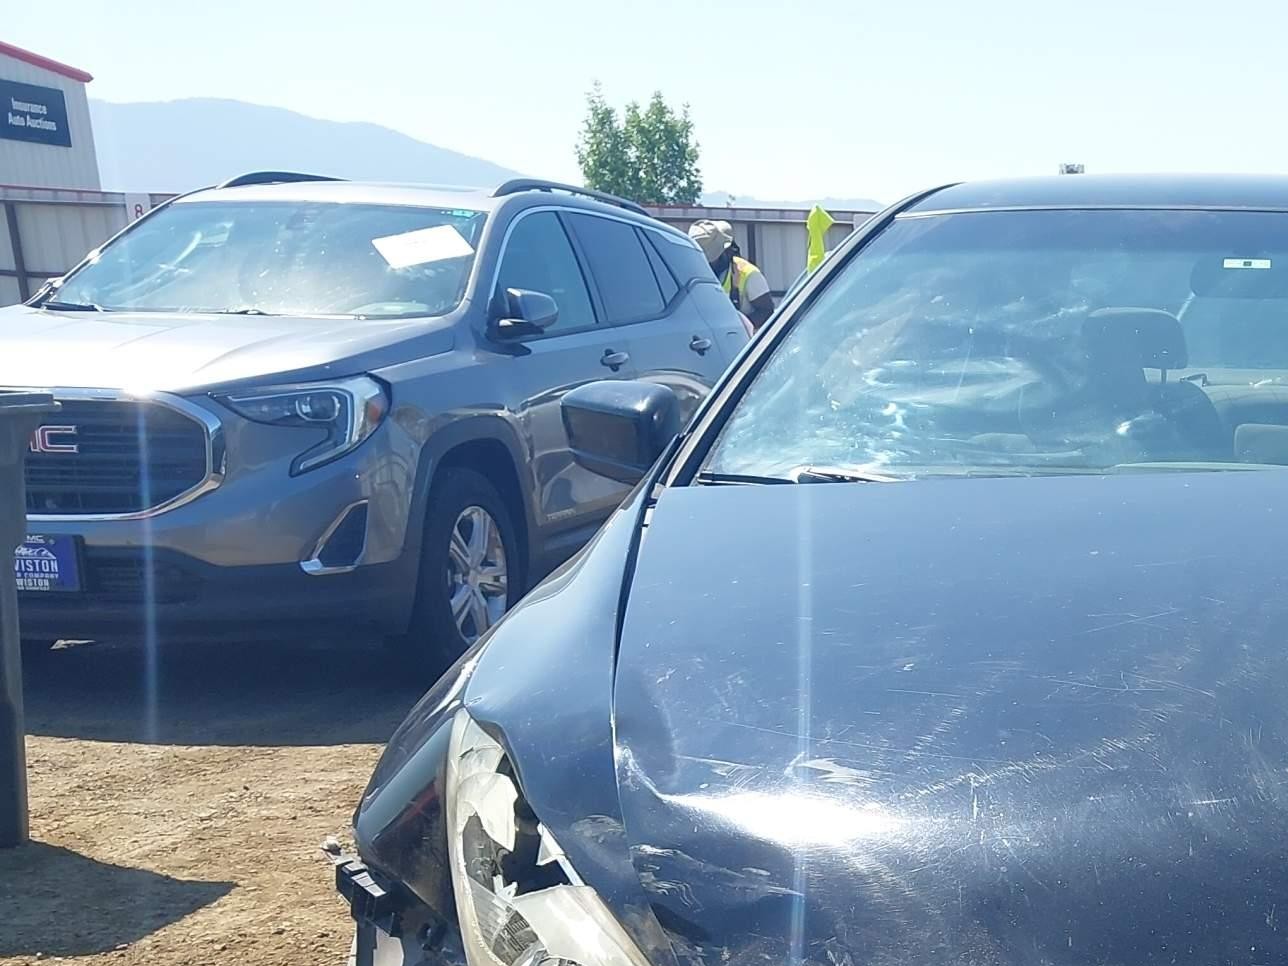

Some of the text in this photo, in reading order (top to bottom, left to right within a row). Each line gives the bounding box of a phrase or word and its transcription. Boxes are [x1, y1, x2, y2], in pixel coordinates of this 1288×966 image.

[11, 96, 47, 115] Insurance
[8, 112, 57, 131] Auto Auctions
